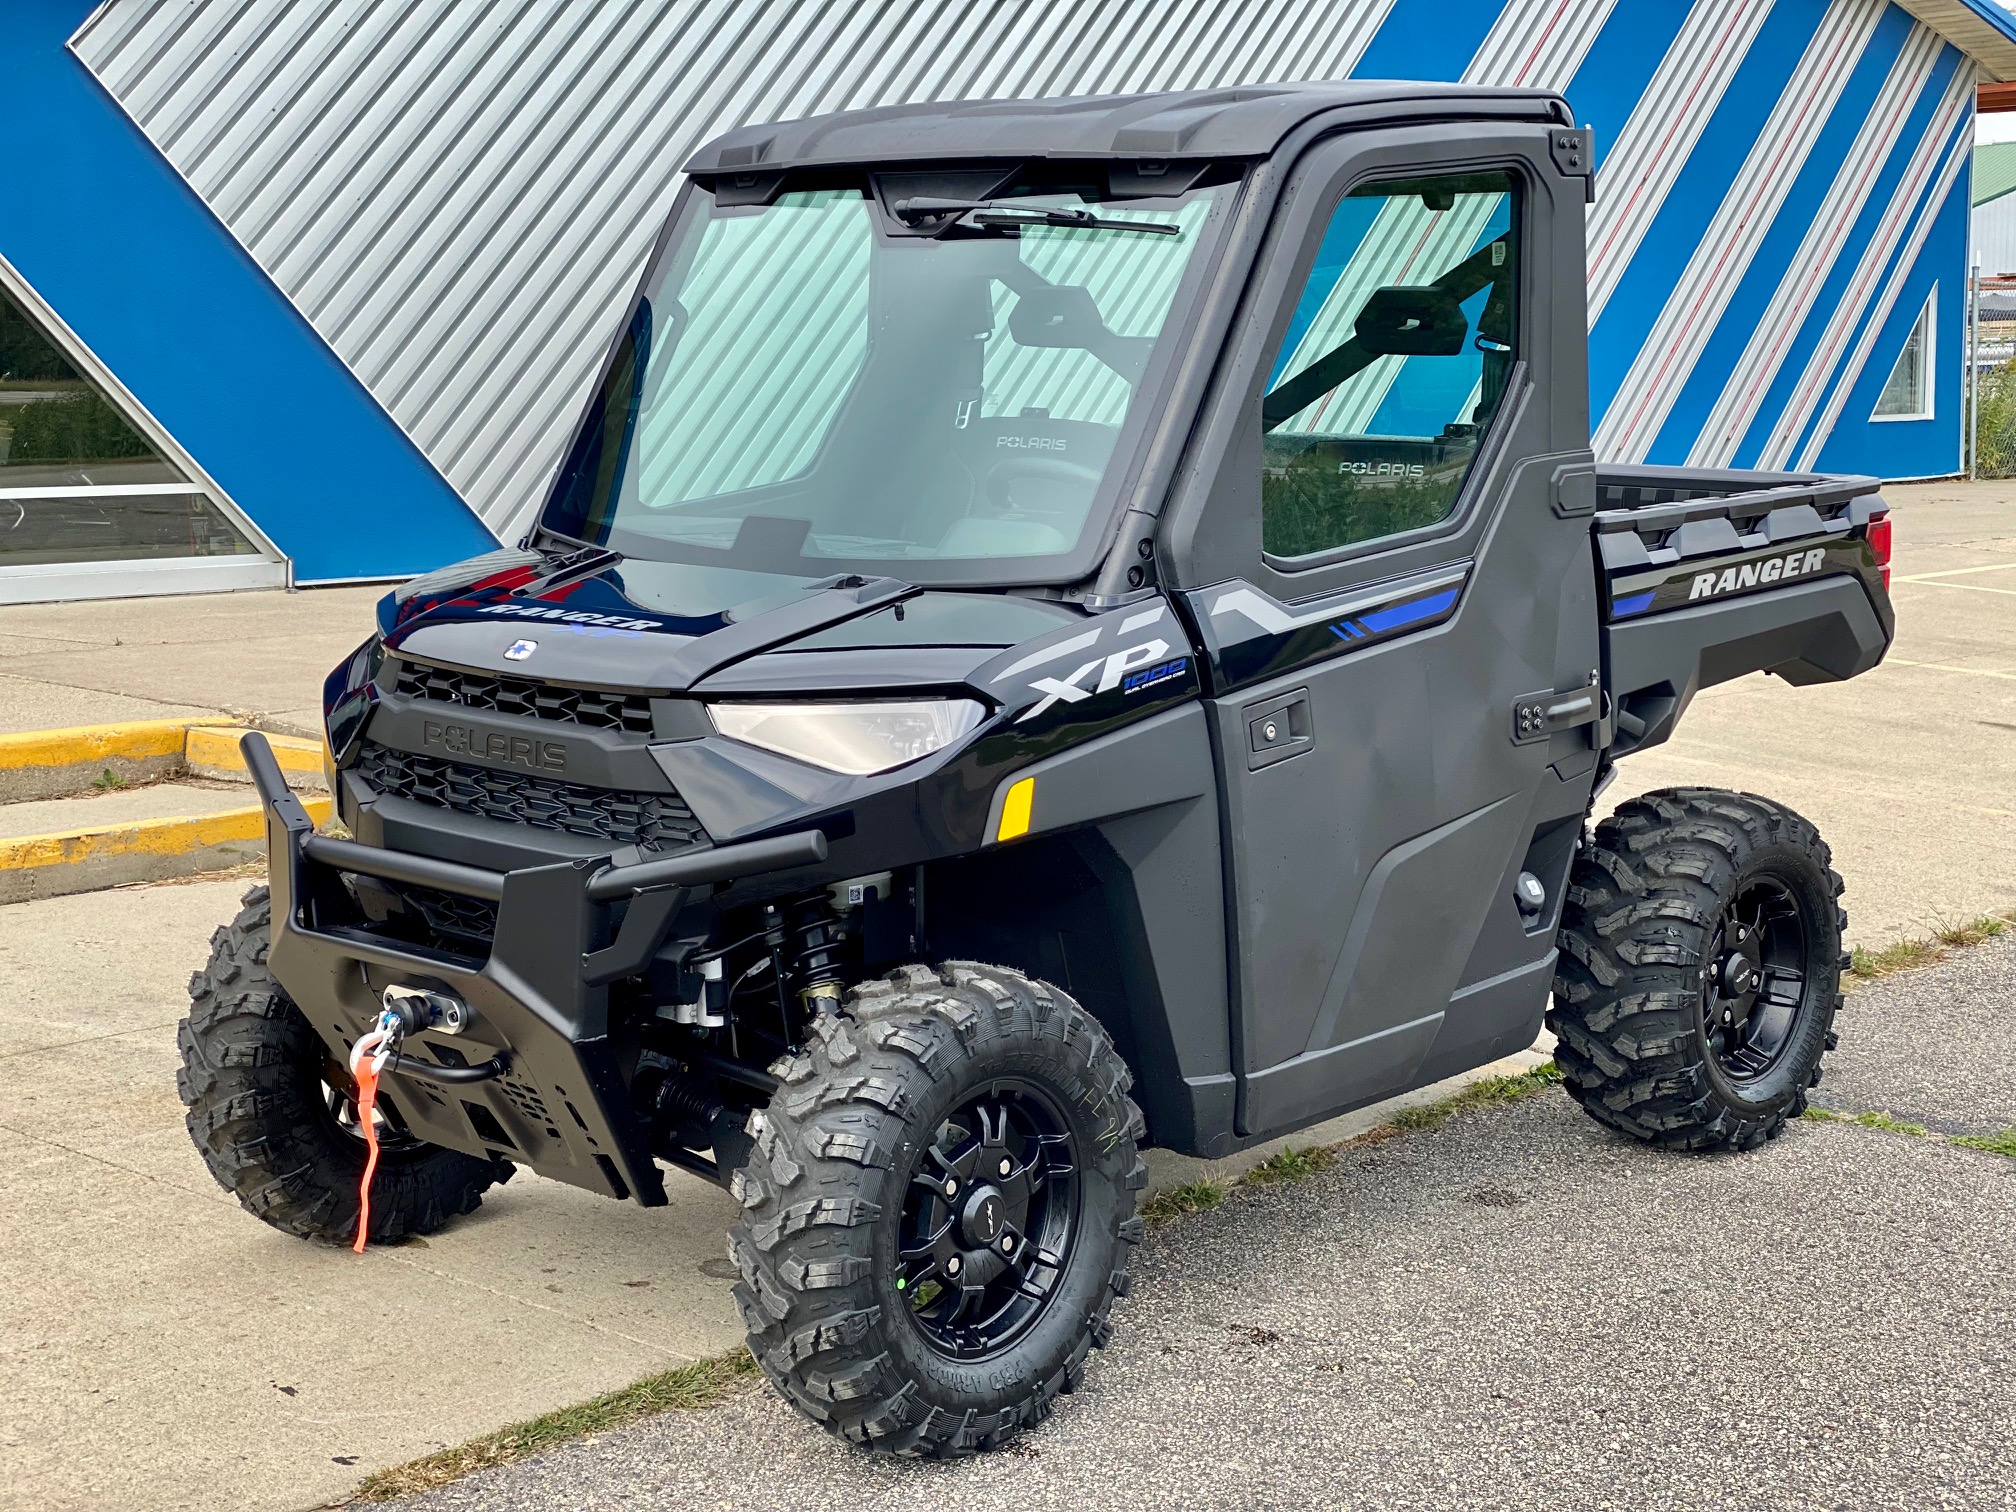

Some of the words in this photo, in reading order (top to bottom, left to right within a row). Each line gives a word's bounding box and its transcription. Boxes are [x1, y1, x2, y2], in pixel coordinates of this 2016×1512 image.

[996, 436, 1067, 451] POLARIS
[1338, 461, 1425, 477] POLARIS
[1688, 548, 1826, 600] RANGER
[477, 604, 663, 631] RANGER
[1013, 638, 1170, 725] XP
[1124, 657, 1187, 690] 1000
[423, 720, 567, 773] POLARIS
